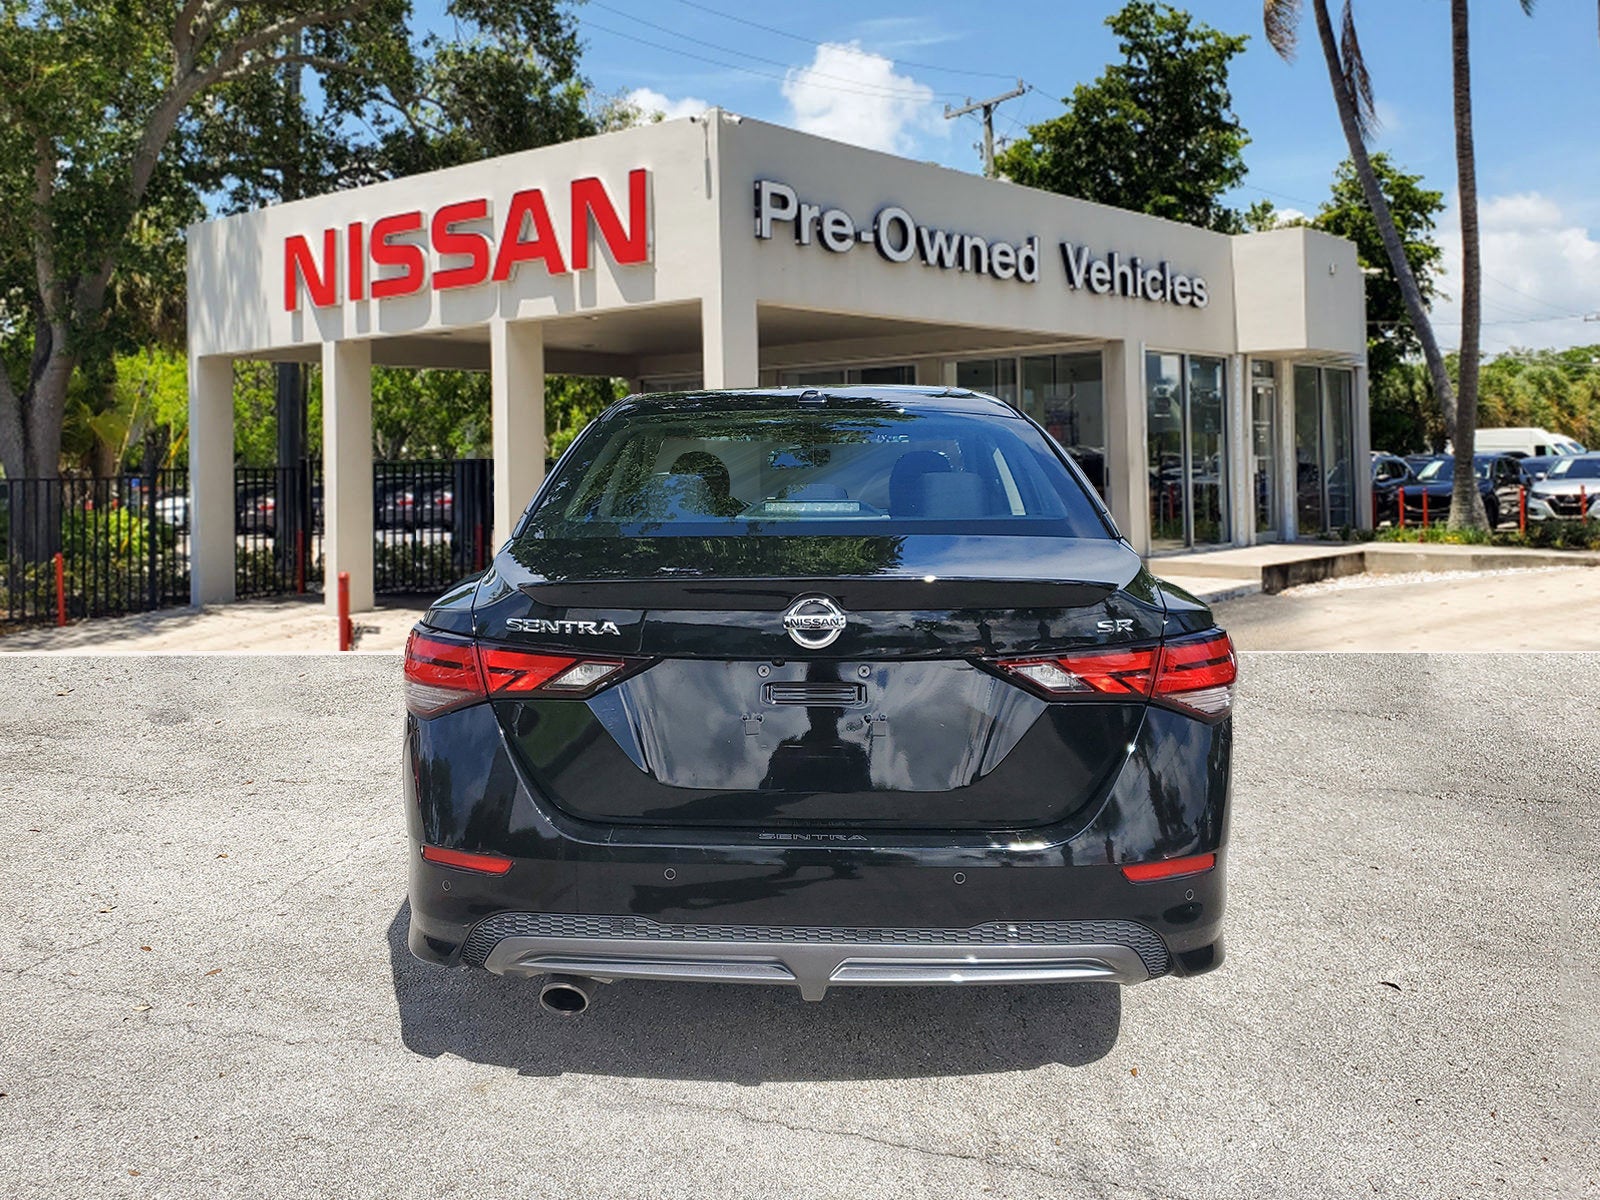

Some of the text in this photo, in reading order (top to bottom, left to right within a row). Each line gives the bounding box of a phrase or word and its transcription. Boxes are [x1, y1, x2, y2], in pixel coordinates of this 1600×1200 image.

[285, 168, 650, 312] NISSAN
[755, 180, 1209, 309] Pre-Owned Vehicles
[505, 617, 621, 637] SENTRA
[789, 617, 840, 628] NISSAN
[1097, 619, 1134, 634] SR
[758, 833, 868, 841] SENTRA
